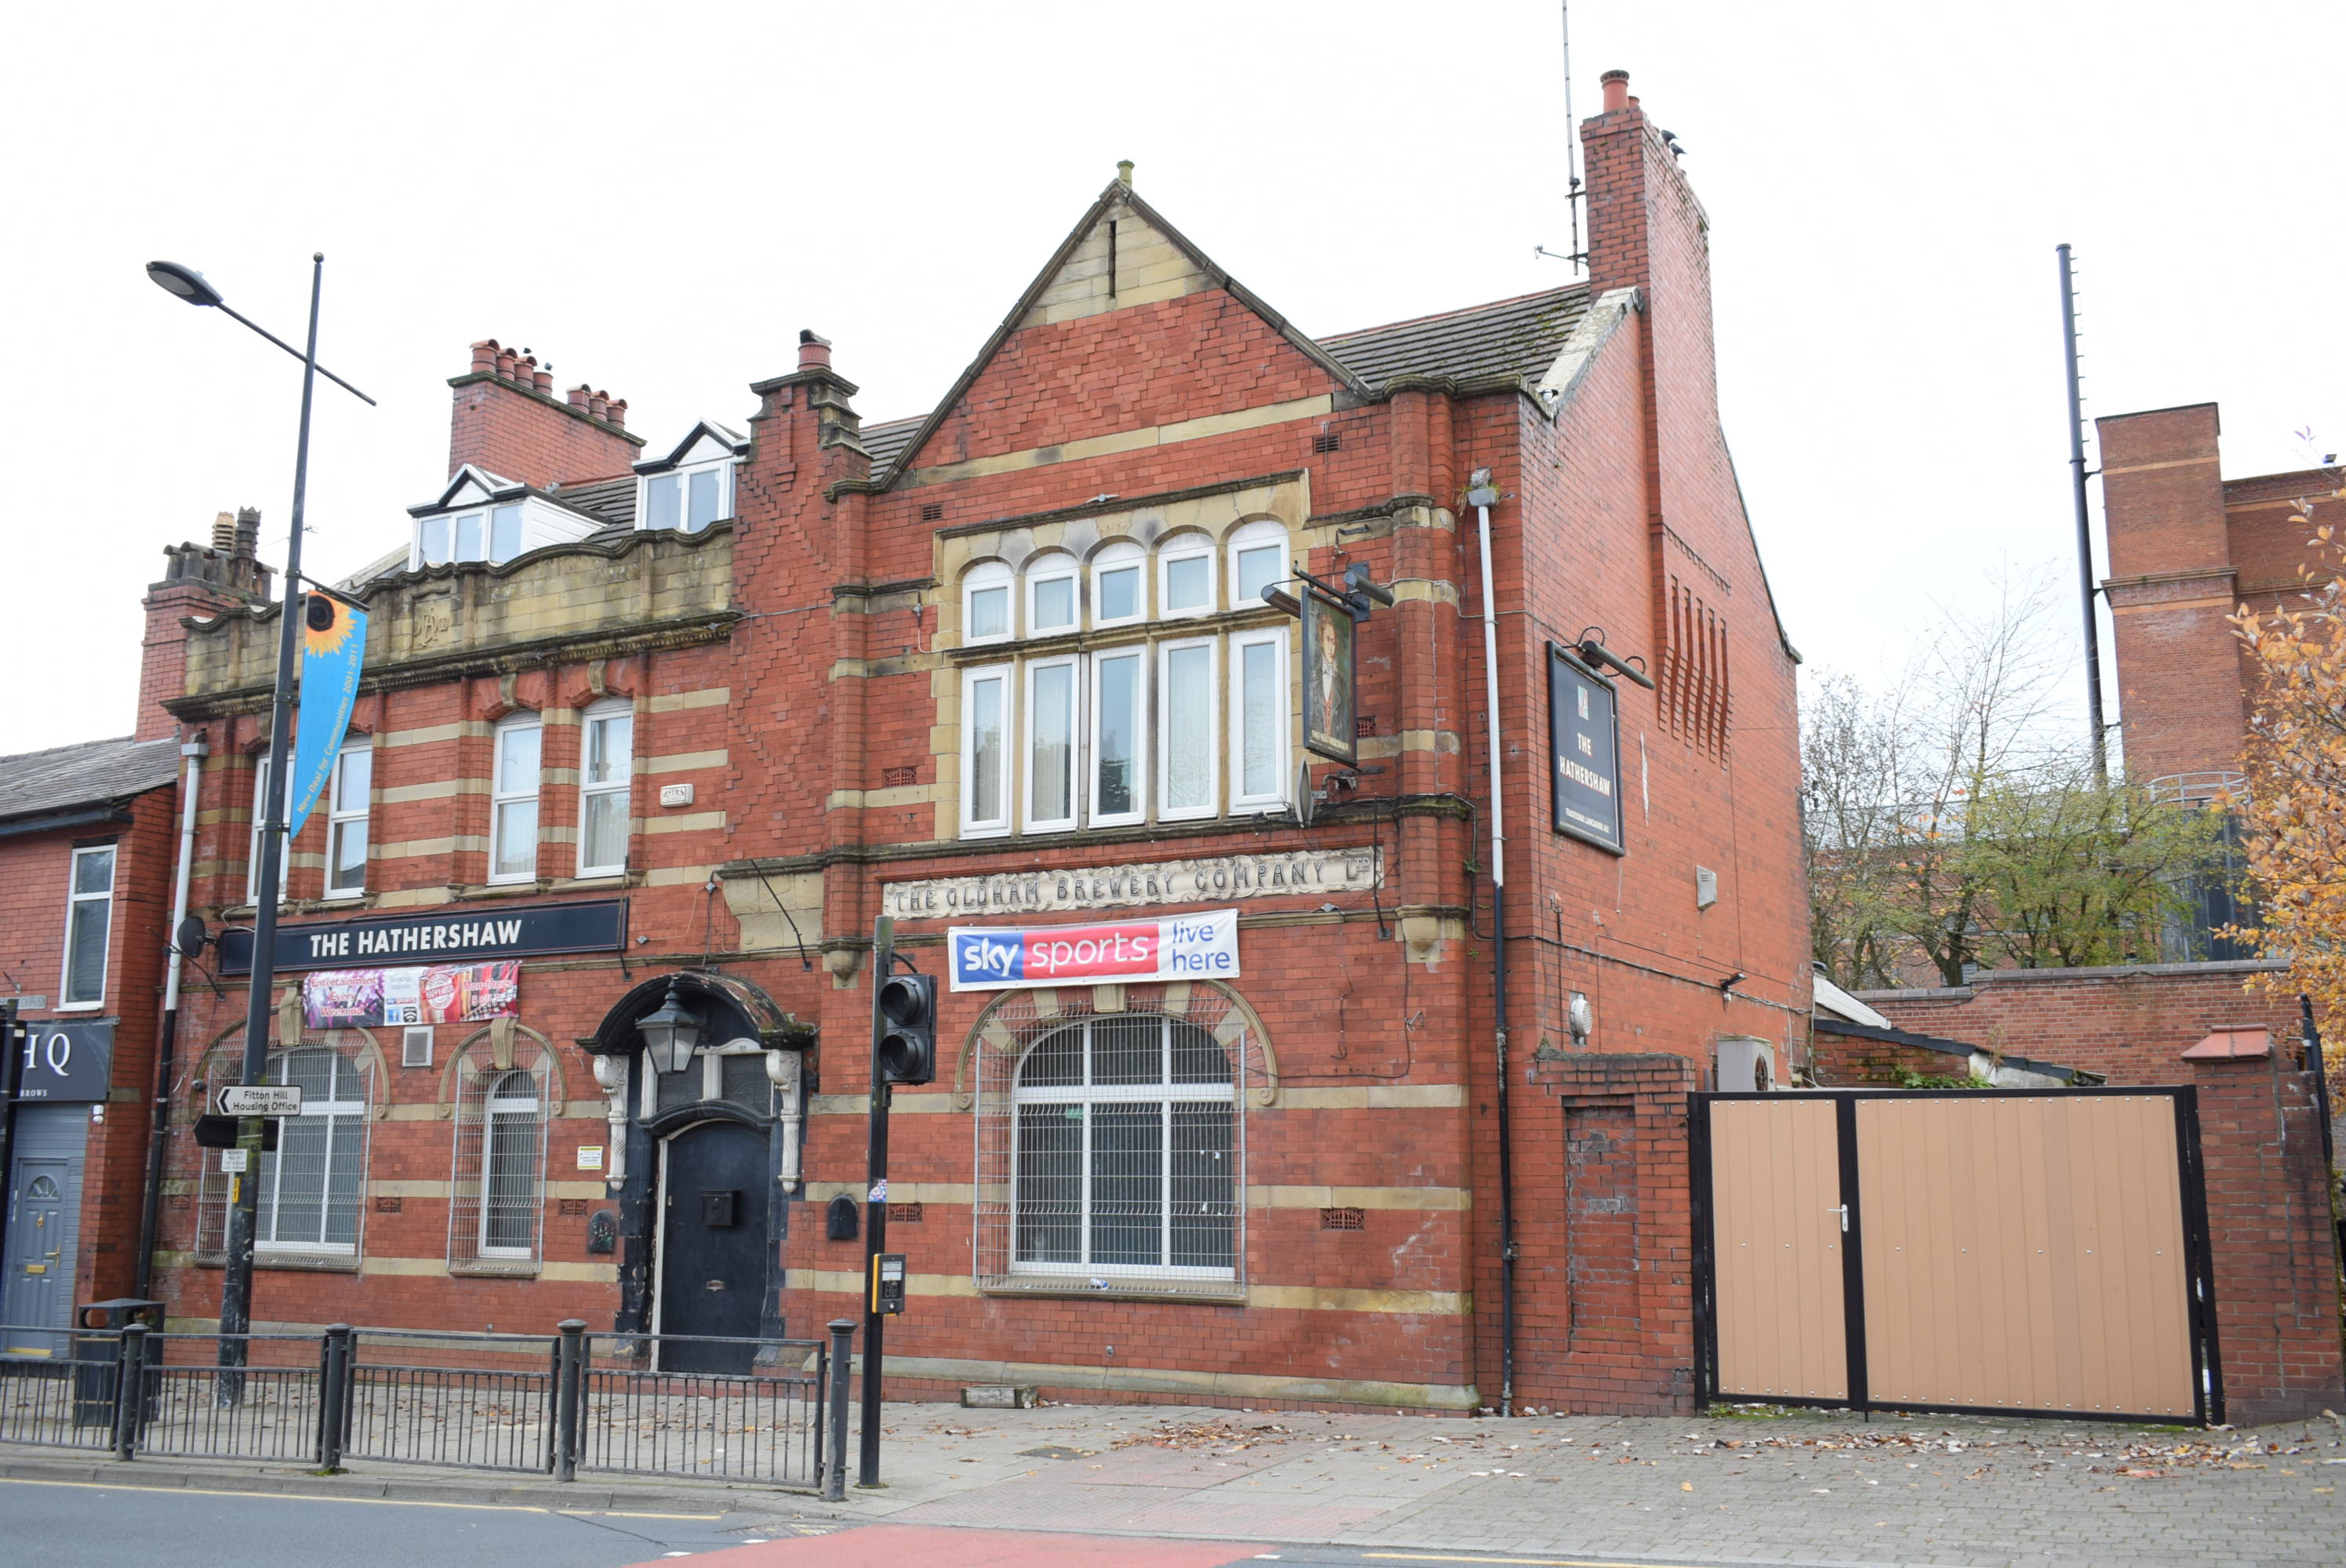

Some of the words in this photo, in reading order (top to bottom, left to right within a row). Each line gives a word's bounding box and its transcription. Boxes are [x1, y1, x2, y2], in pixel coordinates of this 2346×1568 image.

[297, 793, 312, 813] New
[308, 771, 322, 793] Deal
[318, 756, 329, 771] for
[324, 696, 349, 756] Communities
[343, 644, 358, 695] 2001-2011
[1577, 732, 1592, 756] THE
[1559, 755, 1611, 797] HATHERSHAW
[895, 889, 937, 912] THE
[946, 880, 1040, 907] OLDHAM
[1057, 872, 1175, 900] BREWERY
[1194, 861, 1325, 892] COMPANY
[310, 932, 350, 958] THE
[357, 919, 523, 955] HATHERSHAW
[1171, 921, 1215, 946] live
[964, 937, 1019, 978] sky
[1030, 931, 1149, 975] sports
[1171, 949, 1231, 972] here
[310, 976, 378, 987] Entertainment
[329, 992, 357, 1002] Every
[321, 1007, 365, 1017] Weekend
[20, 1089, 48, 1098] BROWS
[245, 1091, 271, 1100] Fitton
[274, 1091, 289, 1099] Hill
[233, 1102, 269, 1112] Housing
[271, 1102, 298, 1111] Office
